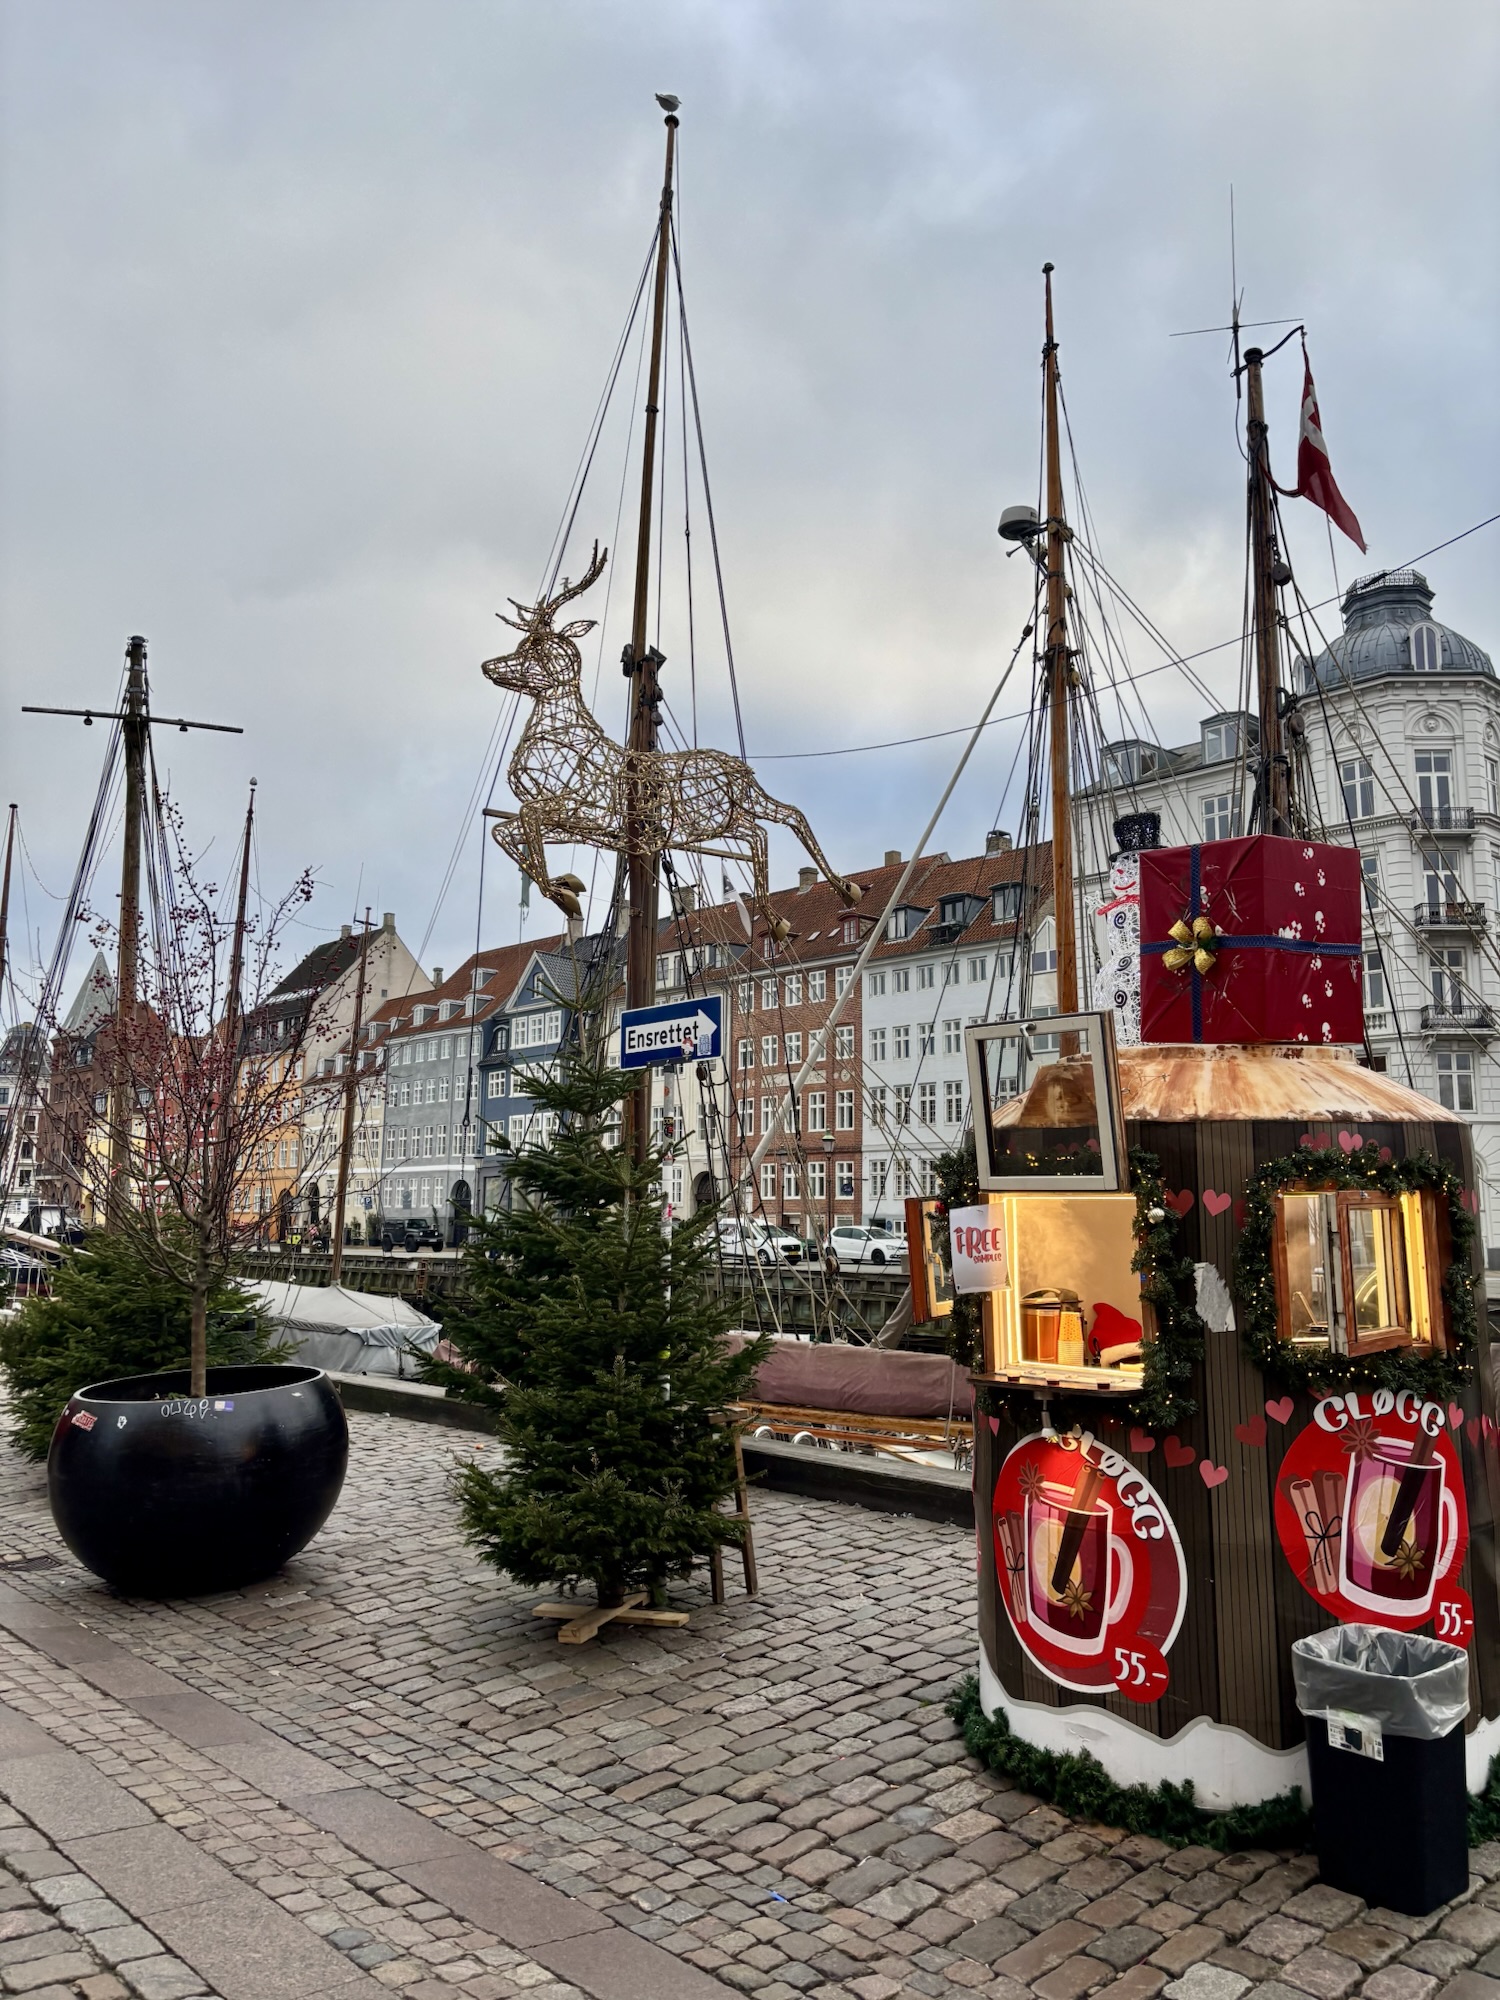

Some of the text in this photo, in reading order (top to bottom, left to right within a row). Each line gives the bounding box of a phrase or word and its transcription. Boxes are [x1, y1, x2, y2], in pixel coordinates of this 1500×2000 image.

[628, 1021, 699, 1050] Ensrettet
[953, 1226, 1002, 1259] FREE
[973, 1253, 1002, 1264] SAMPLES
[1313, 1388, 1446, 1438] GLØGG
[1058, 1424, 1166, 1541] GLØGG
